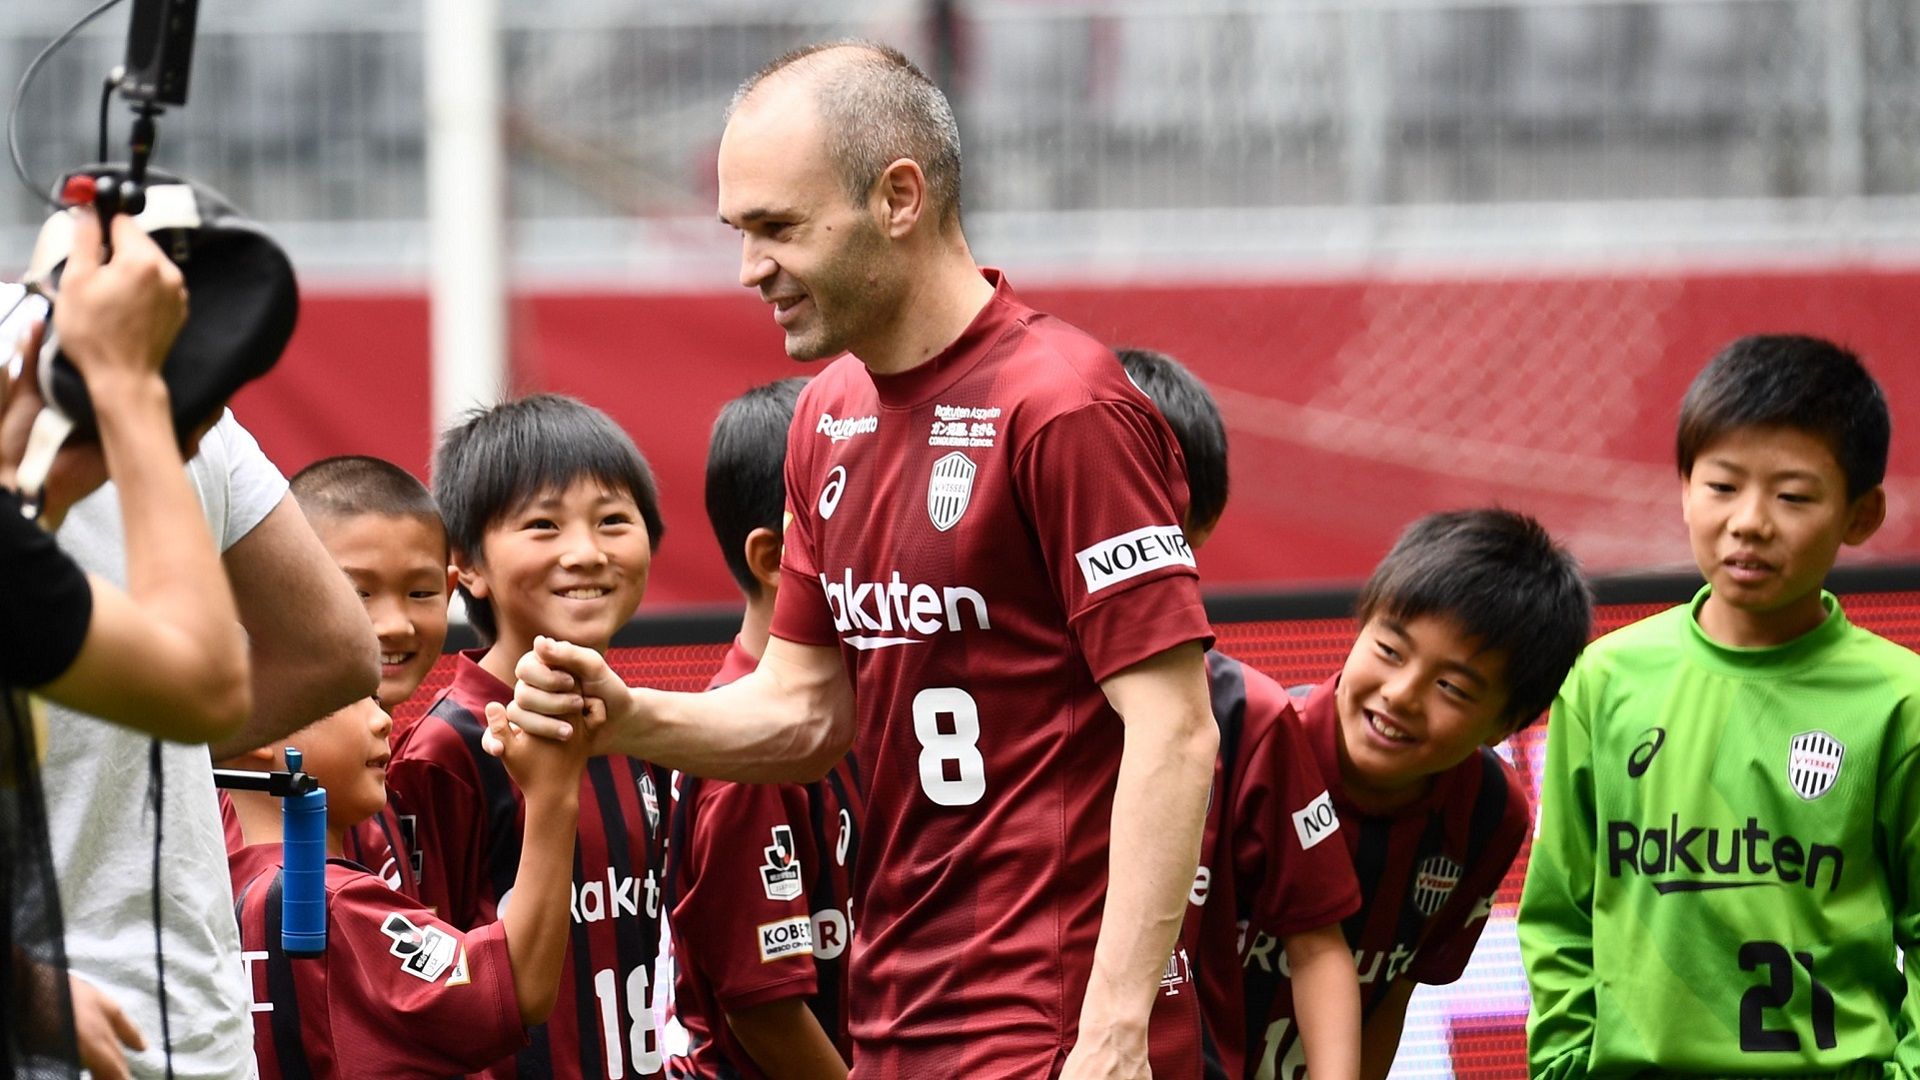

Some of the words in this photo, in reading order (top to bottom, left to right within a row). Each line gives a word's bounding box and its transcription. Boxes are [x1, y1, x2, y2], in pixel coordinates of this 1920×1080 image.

[912, 687, 986, 806] 8
[1303, 800, 1336, 839] NO
[1608, 812, 1844, 892] Rakuten
[1738, 940, 1838, 1053] 21
